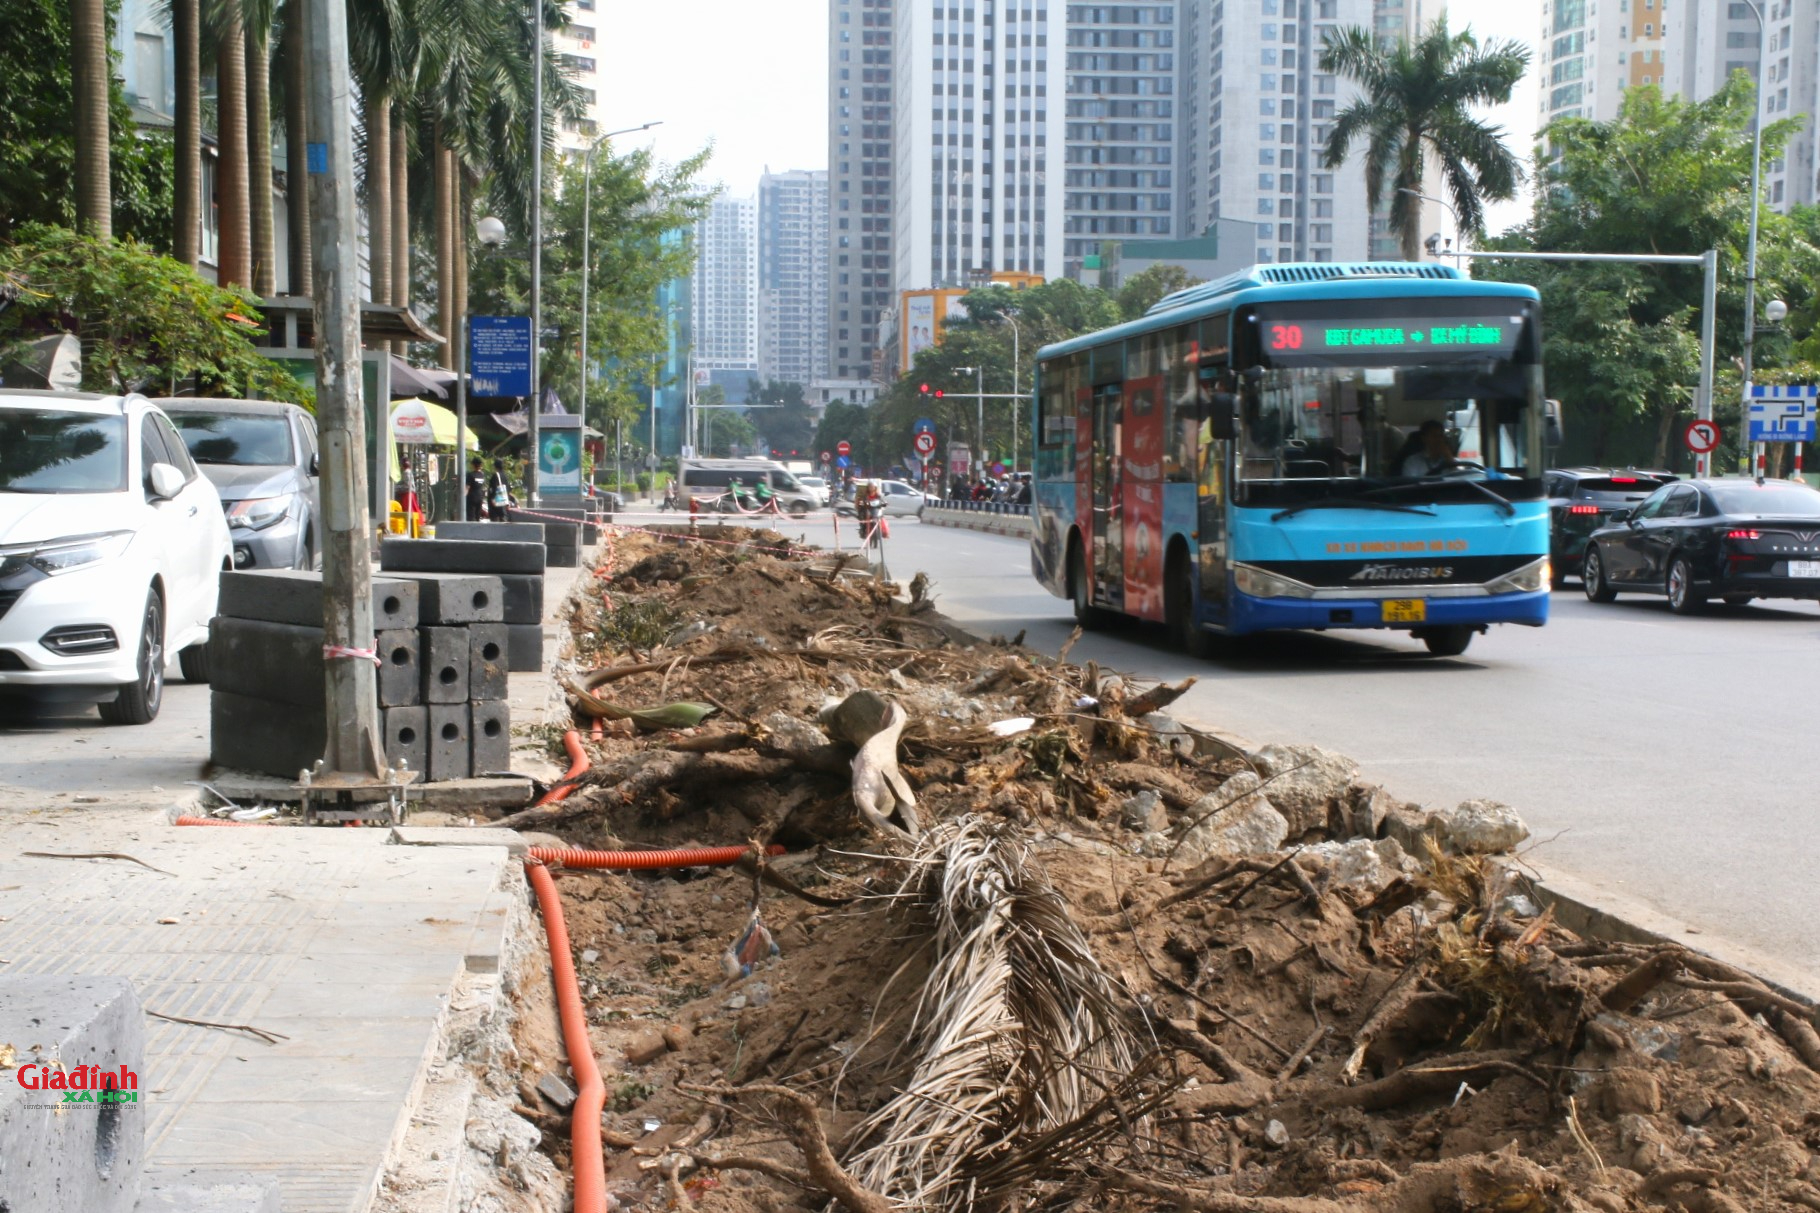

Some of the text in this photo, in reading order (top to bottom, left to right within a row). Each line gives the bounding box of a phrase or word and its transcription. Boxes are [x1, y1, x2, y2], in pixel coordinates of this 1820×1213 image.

[1271, 325, 1303, 350] 30
[1350, 328, 1405, 346] GAMUDA
[1349, 563, 1454, 580] HANOIBUS
[1394, 600, 1413, 610] 29B
